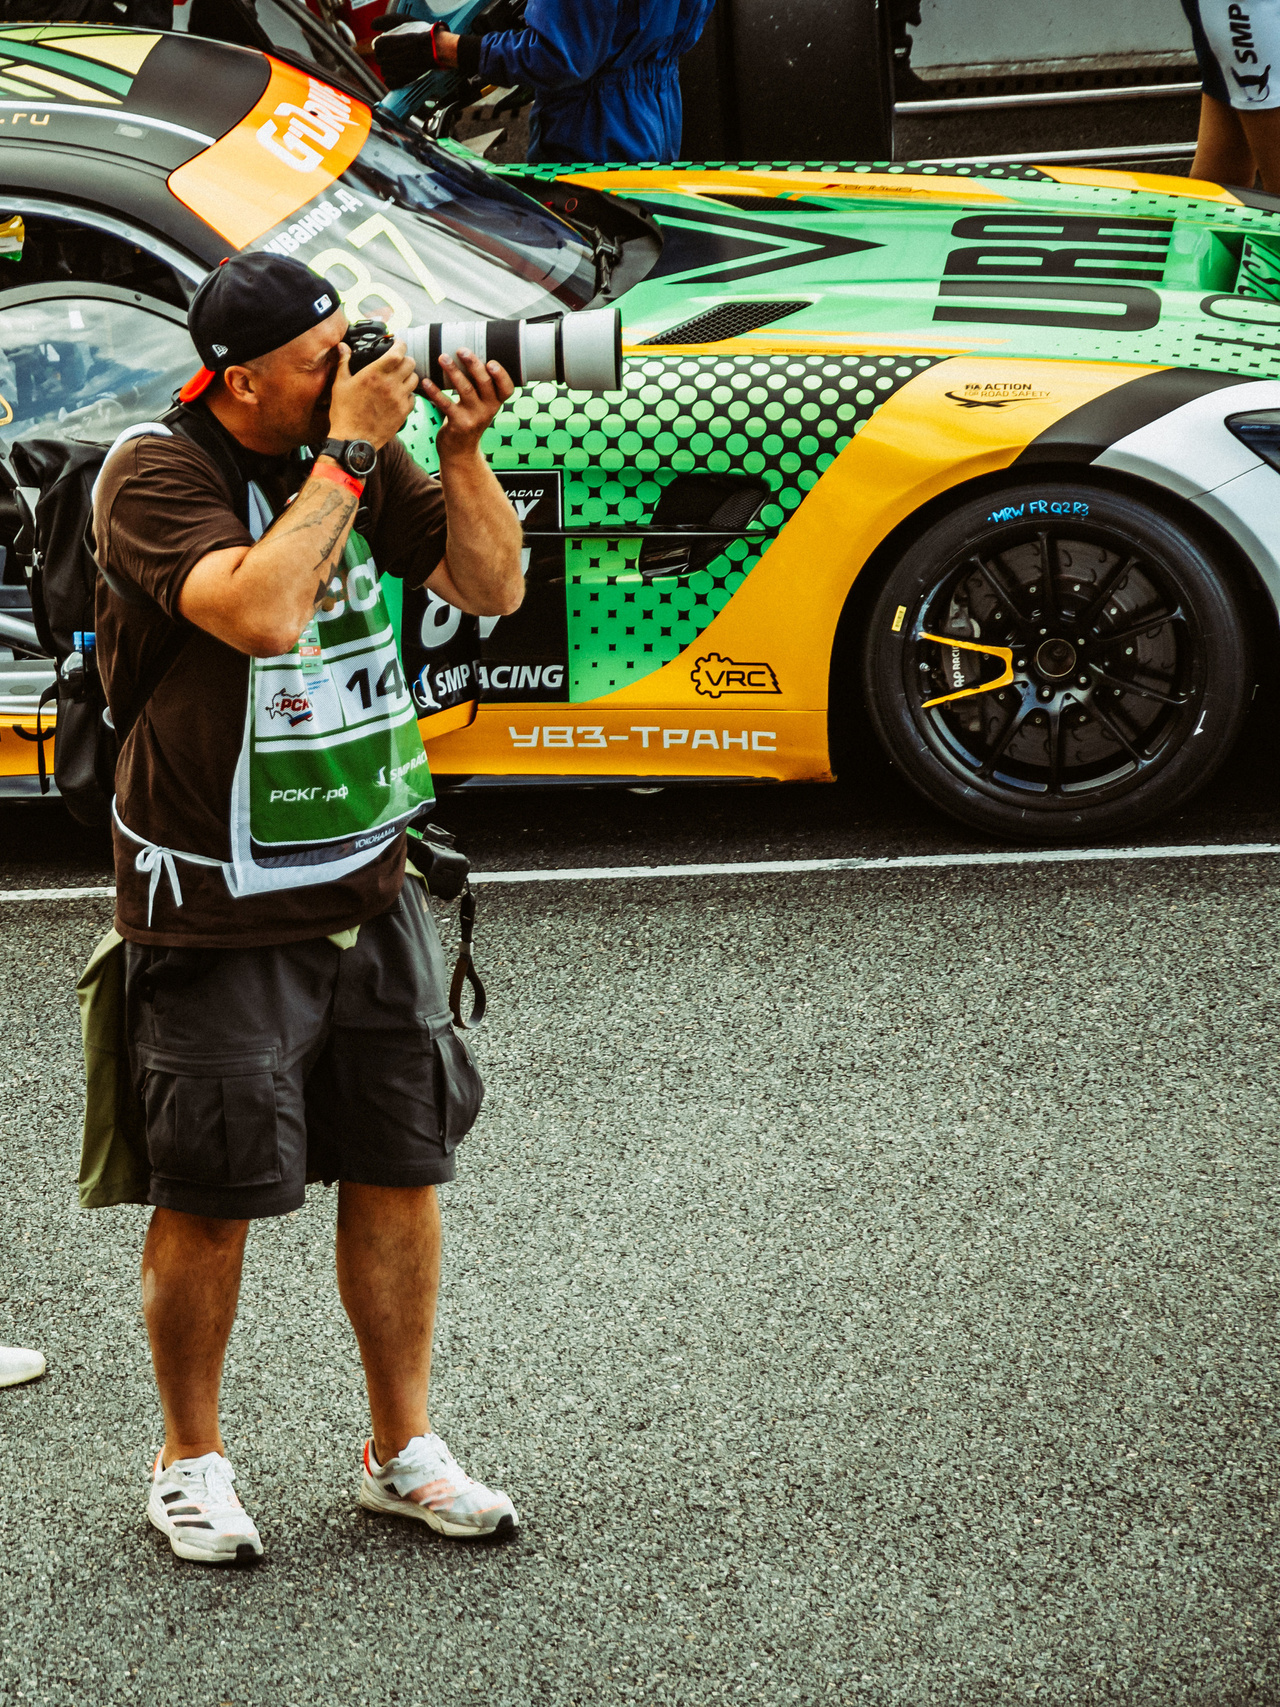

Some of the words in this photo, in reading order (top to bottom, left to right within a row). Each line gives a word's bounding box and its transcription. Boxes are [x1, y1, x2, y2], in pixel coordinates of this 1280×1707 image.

[1228, 3, 1258, 64] SMP
[308, 212, 447, 336] 87
[932, 208, 1177, 332] URA
[346, 657, 408, 710] 14
[435, 663, 471, 697] SMP
[705, 671, 766, 687] VRC
[508, 726, 777, 751] УВЗ-ТРАНС
[390, 763, 410, 781] SMP
[270, 783, 349, 802] РСКГ.рф
[355, 826, 396, 849] YOKOHAMA
